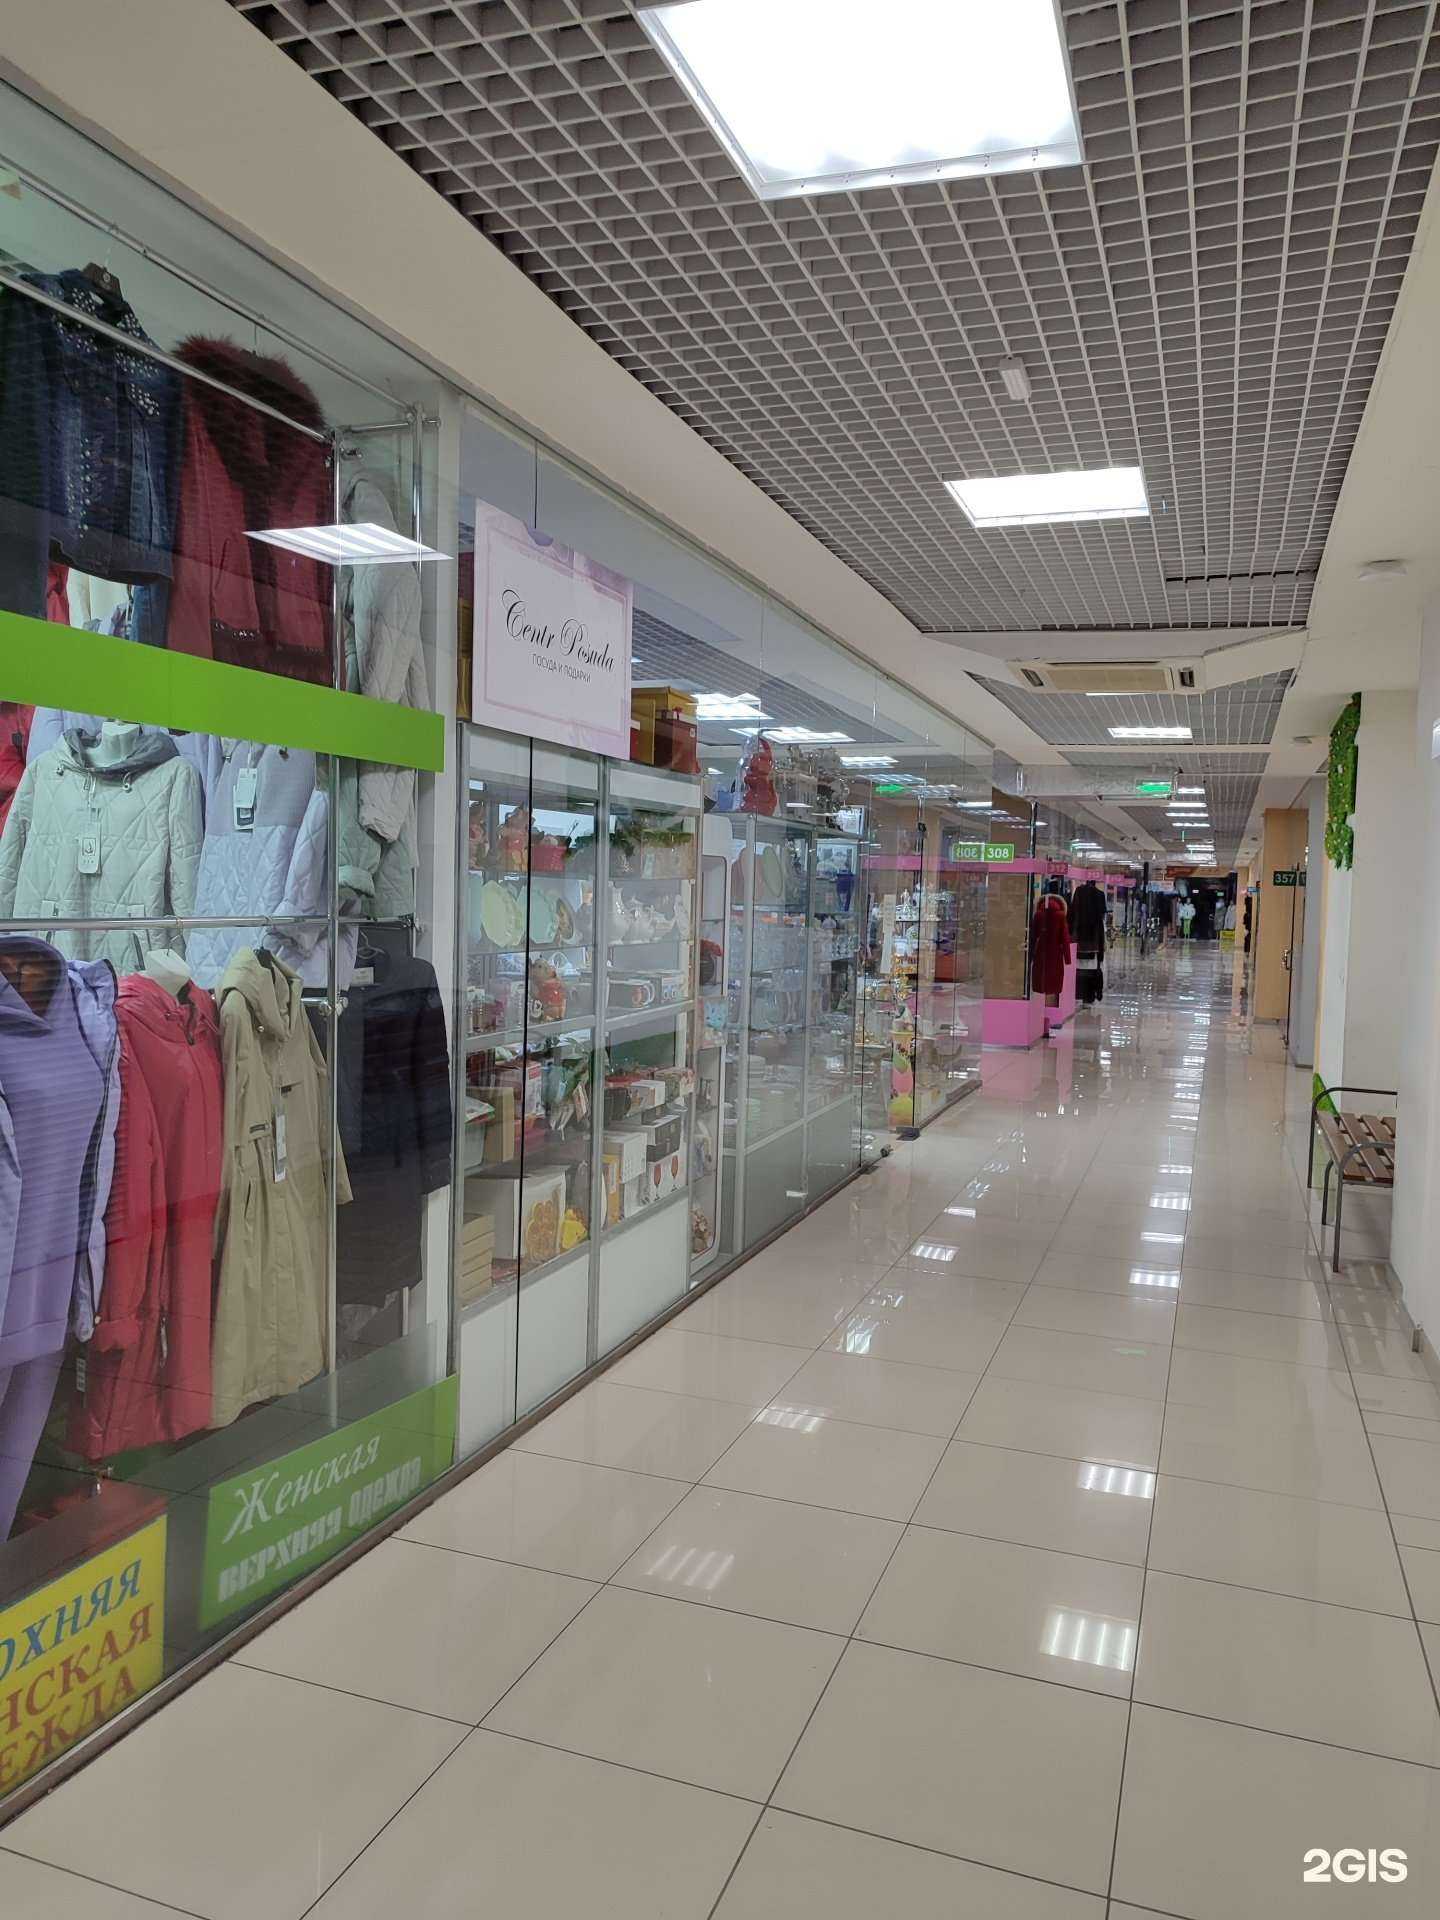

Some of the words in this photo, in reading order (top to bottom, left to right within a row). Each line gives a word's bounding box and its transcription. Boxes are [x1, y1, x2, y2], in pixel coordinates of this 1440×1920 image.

[502, 589, 555, 649] Centr
[560, 619, 615, 673] Posuda
[532, 653, 557, 672] ПОСУДА
[559, 662, 564, 673] И
[565, 664, 591, 683] ПОДАРКИ
[987, 847, 1009, 858] 308
[1275, 873, 1295, 883] 357
[222, 1435, 380, 1544] Женская
